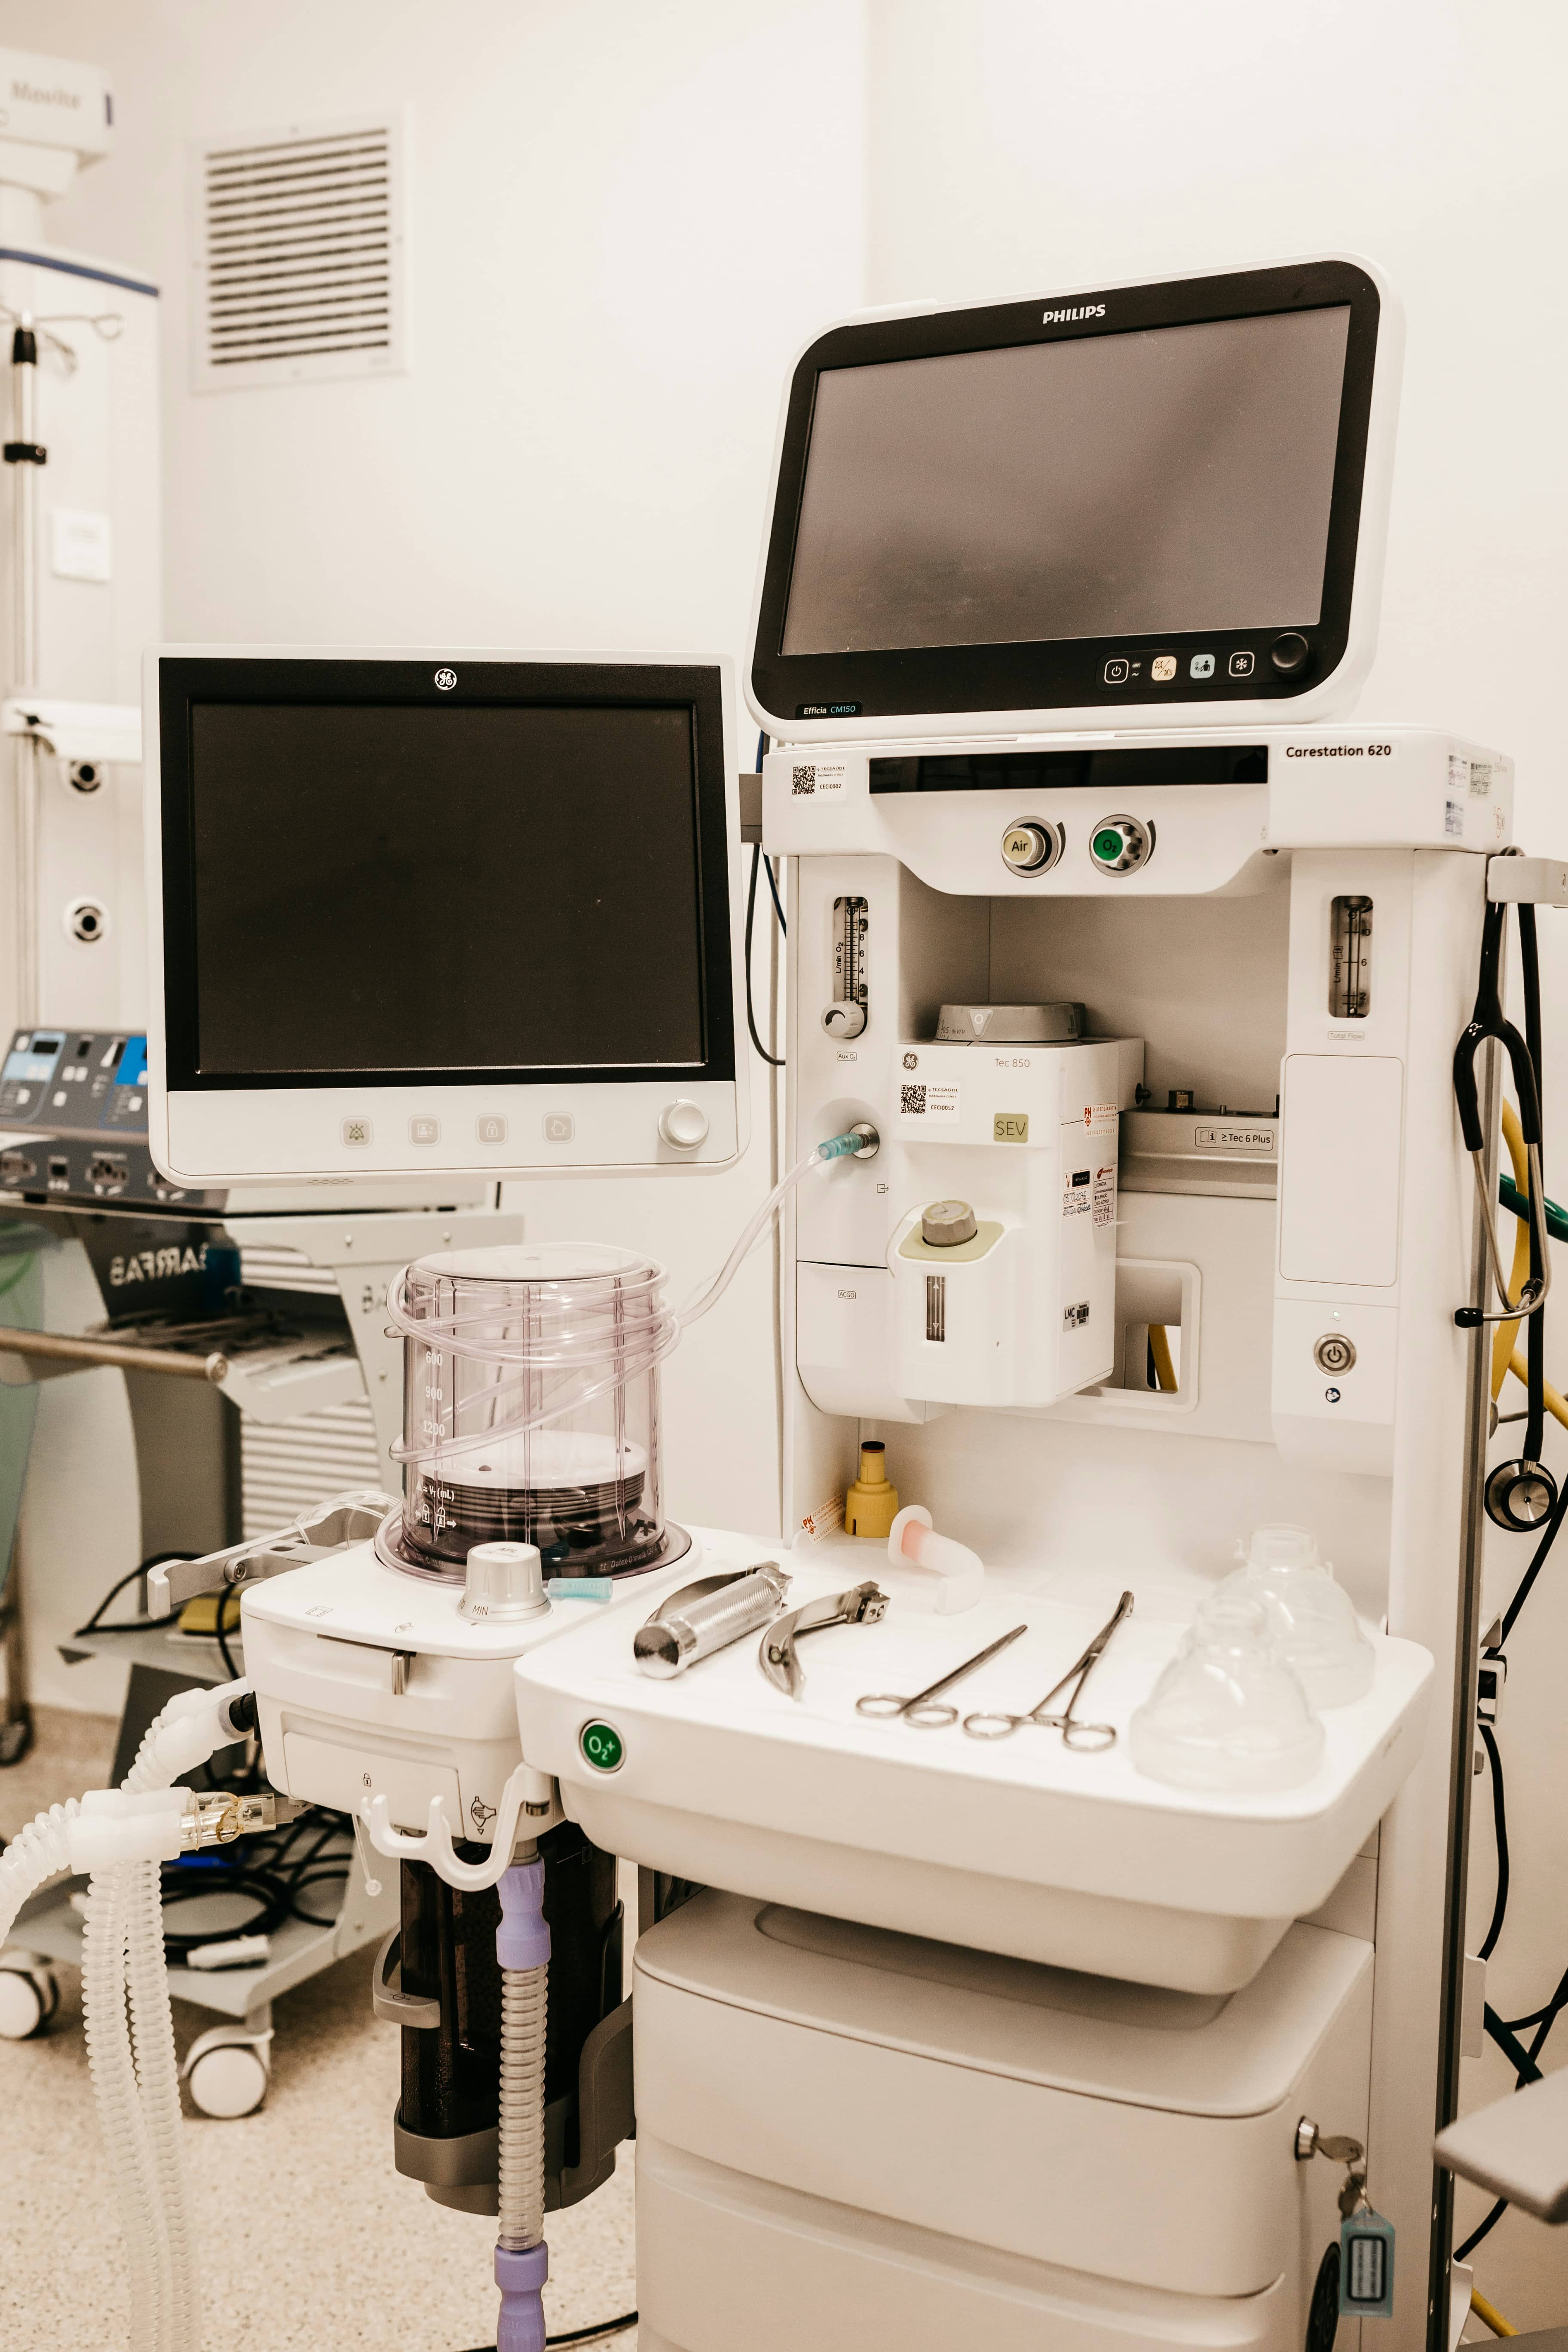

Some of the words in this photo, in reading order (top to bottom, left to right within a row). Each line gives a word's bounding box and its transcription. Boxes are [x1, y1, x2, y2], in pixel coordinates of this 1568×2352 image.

[1043, 304, 1106, 324] PHILIPS
[1286, 745, 1363, 757] Carestation
[1368, 745, 1391, 756] 620
[1012, 841, 1028, 851] Air
[994, 1059, 1010, 1067] Tec
[1012, 1059, 1030, 1068] 850
[1084, 1107, 1091, 1118] PH
[996, 1121, 1026, 1136] SEV
[1253, 1135, 1271, 1143] Plus
[1065, 1307, 1075, 1320] LMC
[426, 1351, 443, 1366] 600
[426, 1385, 442, 1401] 900
[423, 1420, 445, 1437] 1200
[437, 1488, 455, 1502] (mL)
[803, 1515, 814, 1529] PH
[611, 1551, 646, 1568] Datex-Ohmeda
[472, 1605, 488, 1616] MIN
